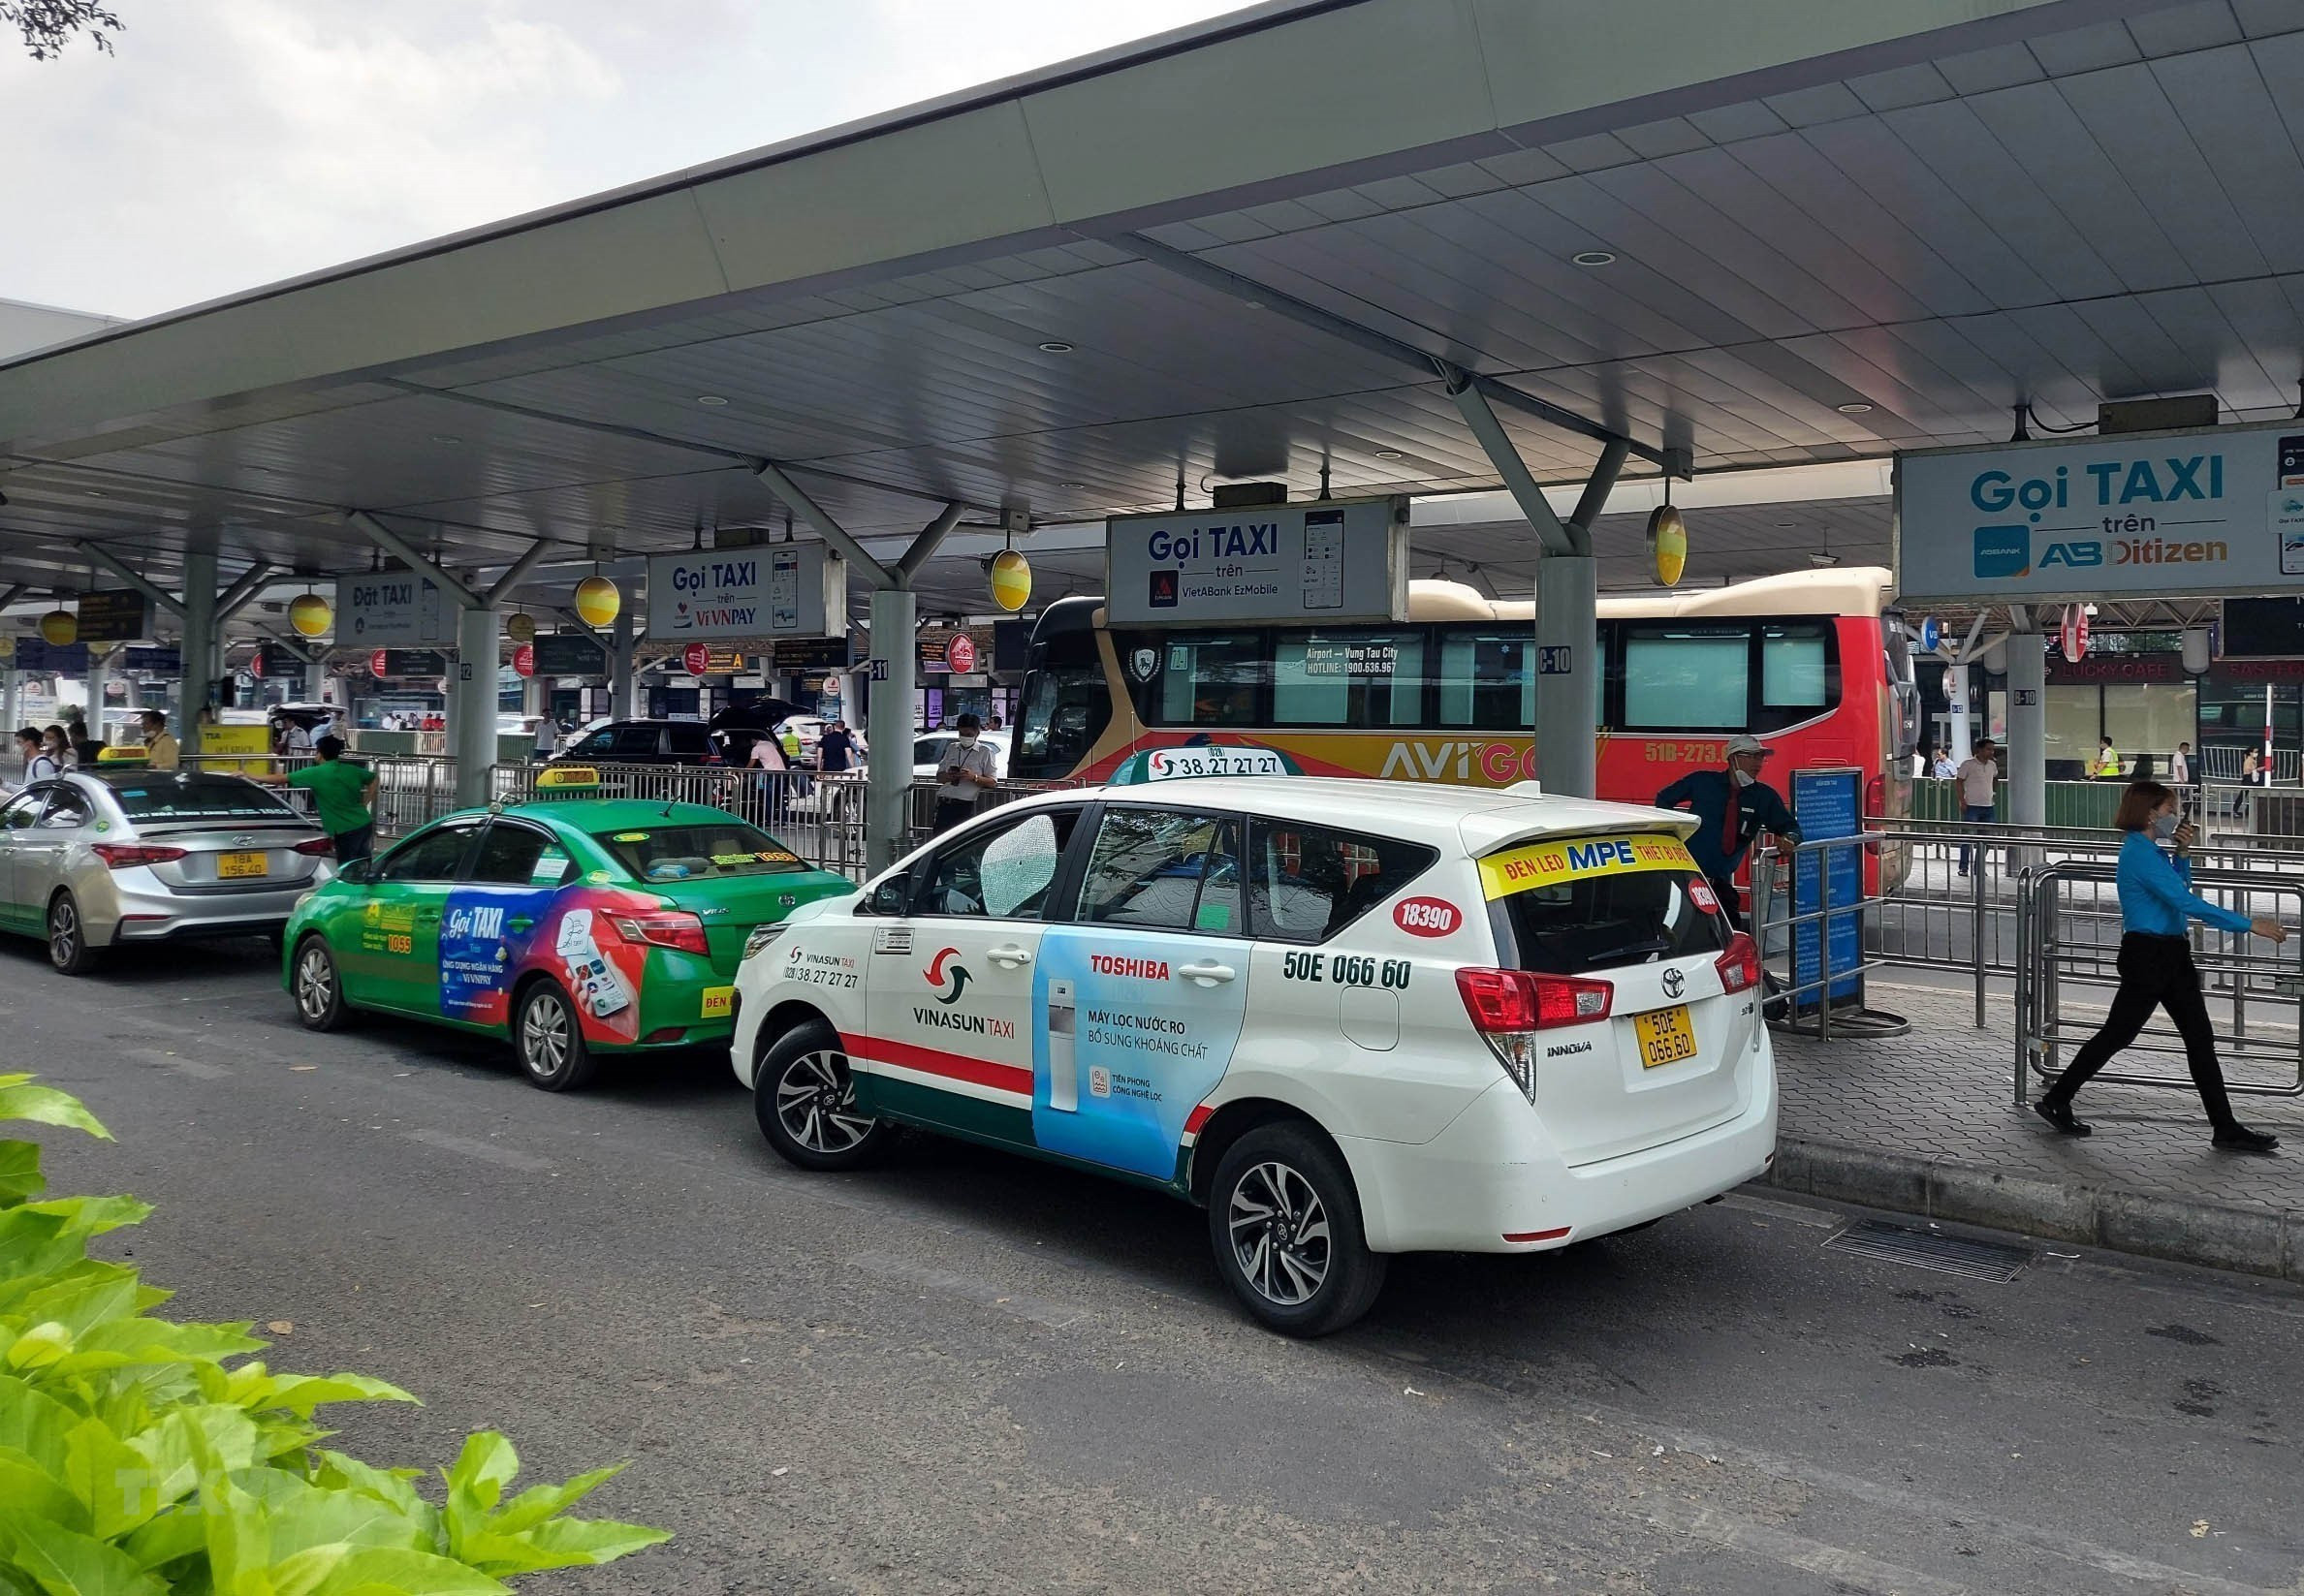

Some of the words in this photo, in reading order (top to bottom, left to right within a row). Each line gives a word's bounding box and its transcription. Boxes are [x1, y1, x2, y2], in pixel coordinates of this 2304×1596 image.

[1971, 466, 2067, 522] Gọi
[2087, 455, 2223, 505] TAXI
[2102, 514, 2155, 533] trên
[1149, 528, 1199, 569] Gọi
[1209, 523, 1277, 557] TAXI
[673, 565, 706, 597] Gọi
[712, 562, 755, 588] TAXI
[1215, 564, 1243, 578] trên
[353, 586, 379, 611] Đặt
[382, 584, 412, 605] TAXI
[717, 594, 735, 604] trên
[1183, 586, 1232, 598] VietABank
[1234, 584, 1278, 596] EzMobile
[711, 608, 756, 626] VNPAY
[734, 654, 742, 667] A
[1307, 648, 1333, 661] Airport
[1344, 647, 1364, 660] Vung
[1366, 647, 1380, 658] Tau
[1382, 647, 1398, 660] City
[1540, 648, 1570, 672] C-10
[1308, 663, 1341, 673] HOTLINE:
[1343, 662, 1396, 673] 1900.636.967
[2015, 691, 2036, 704] B-10
[1180, 758, 1228, 774] 38.27
[1234, 758, 1251, 773] 27
[1258, 758, 1277, 772] 27
[1566, 839, 1637, 870] MPE
[1504, 858, 1538, 880] ĐÈN
[1536, 854, 1564, 873] LED
[449, 909, 472, 939] Gọi
[472, 906, 504, 939] TAXI
[1403, 903, 1452, 931] 18390
[389, 934, 411, 954] 1055
[806, 954, 840, 966] VINASUN
[841, 957, 855, 968] TAXI
[1090, 954, 1169, 981] TOSHIBA
[1283, 951, 1325, 982] 50E
[1332, 954, 1375, 986] 066
[1381, 959, 1411, 989] 60
[798, 968, 827, 984] 38.27
[828, 972, 843, 986] 27
[844, 974, 859, 988] 27
[913, 1007, 985, 1035] VINASUN
[987, 1018, 1016, 1040] TAXI
[1088, 1009, 1110, 1025] MÁY
[1113, 1014, 1132, 1030] LỌC
[1135, 1016, 1167, 1033] NƯỚC
[1170, 1020, 1185, 1034] RO
[1652, 1012, 1677, 1036] 50E
[1104, 1033, 1132, 1048] SUNG
[1134, 1037, 1179, 1055] KHOÁNG
[1547, 1040, 1593, 1058] INNOVA
[1649, 1032, 1690, 1063] 066.60
[1126, 1077, 1151, 1087] PHONG
[1112, 1085, 1130, 1096] CÔNG
[1131, 1088, 1150, 1100] NGHỆ
[1150, 1093, 1162, 1103] LỌC
